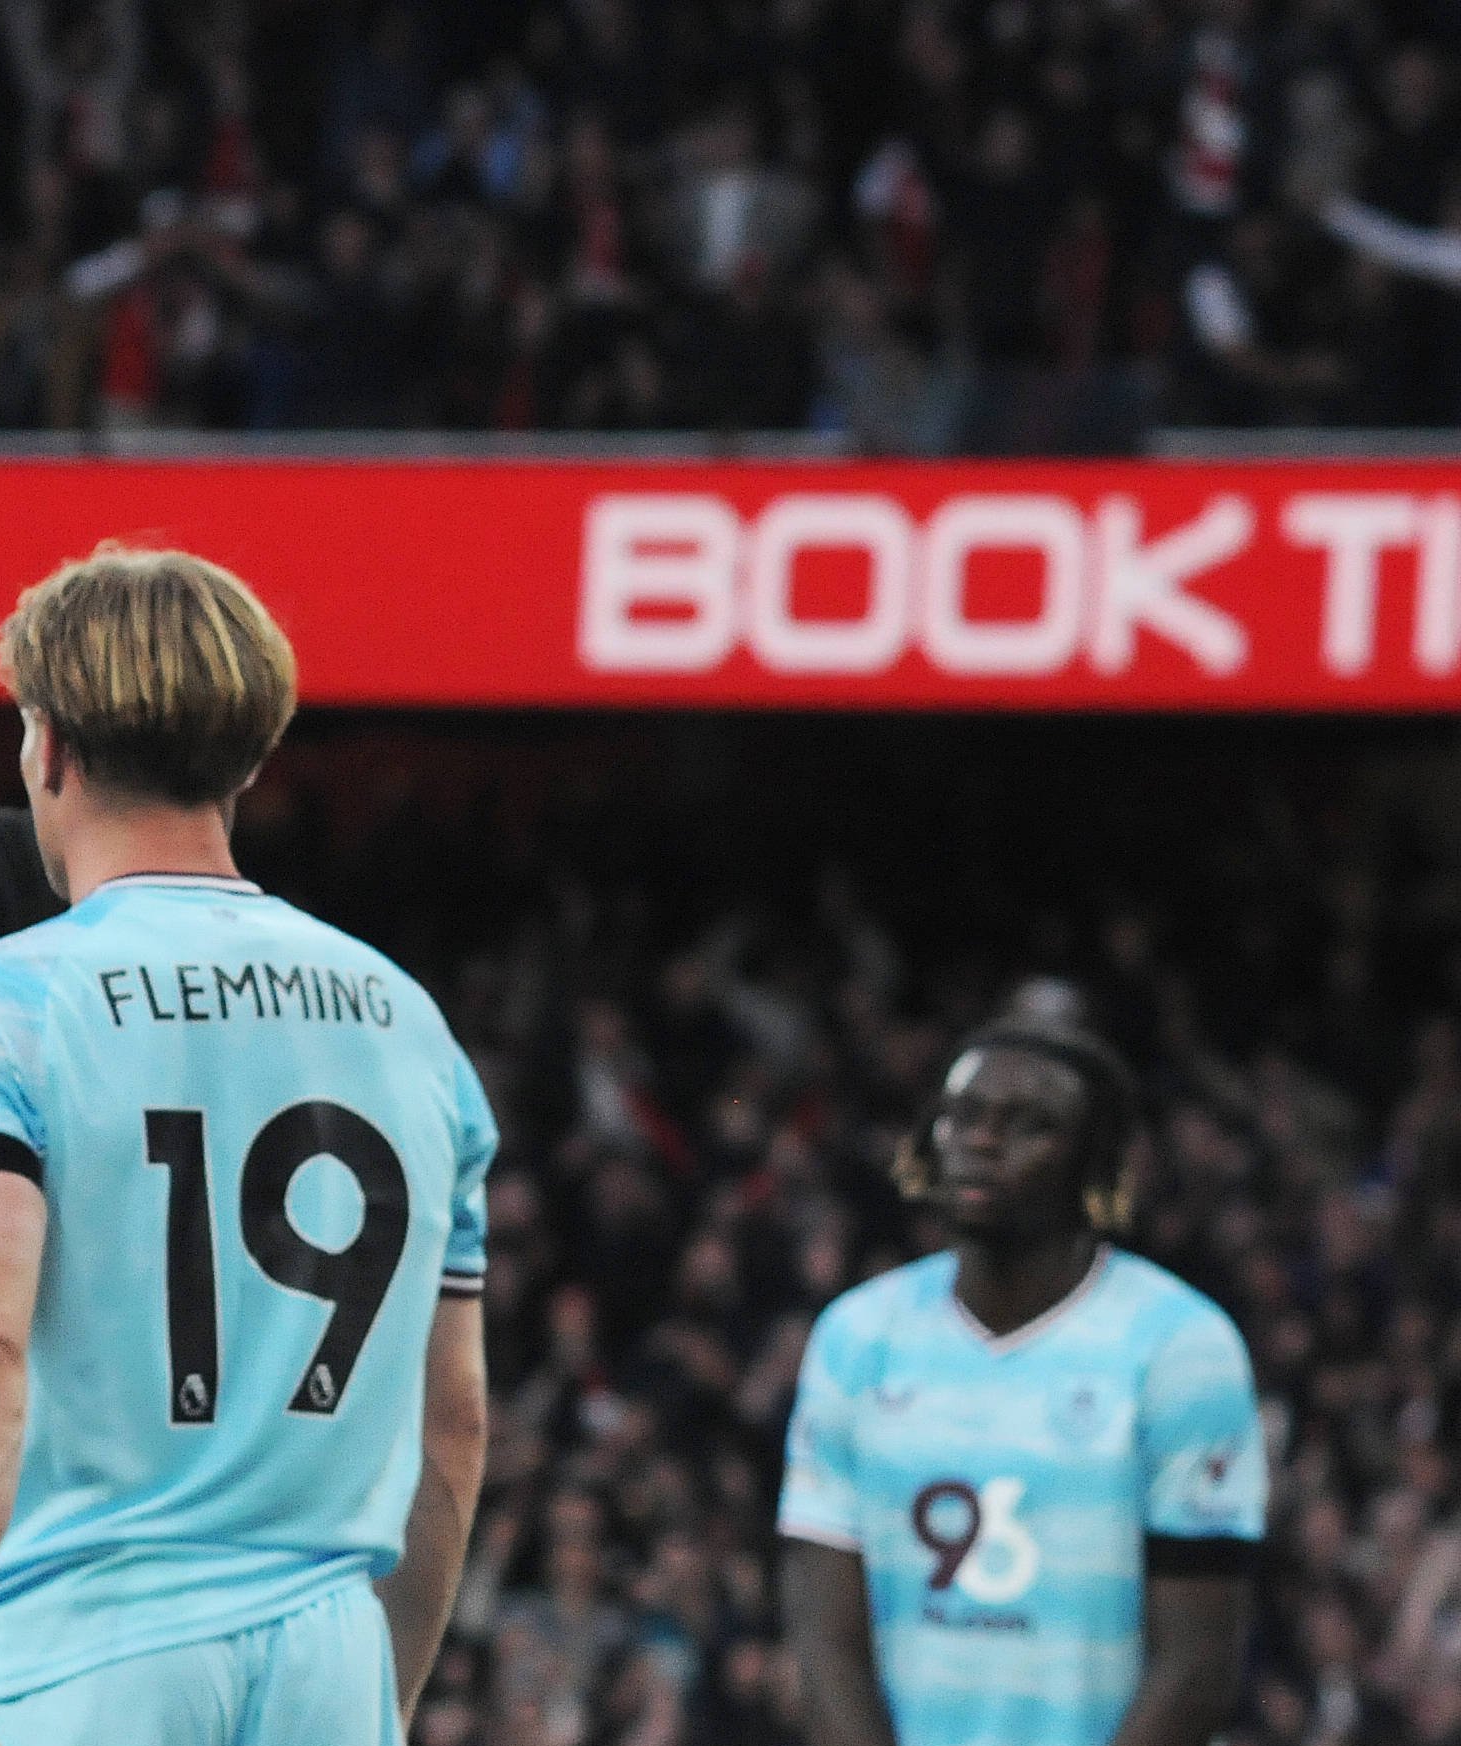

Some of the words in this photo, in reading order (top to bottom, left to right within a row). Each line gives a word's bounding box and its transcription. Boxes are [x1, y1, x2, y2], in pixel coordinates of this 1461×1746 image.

[578, 493, 1256, 677] BOOK
[100, 962, 393, 1028] FLEMMING
[143, 1098, 410, 1425] 19
